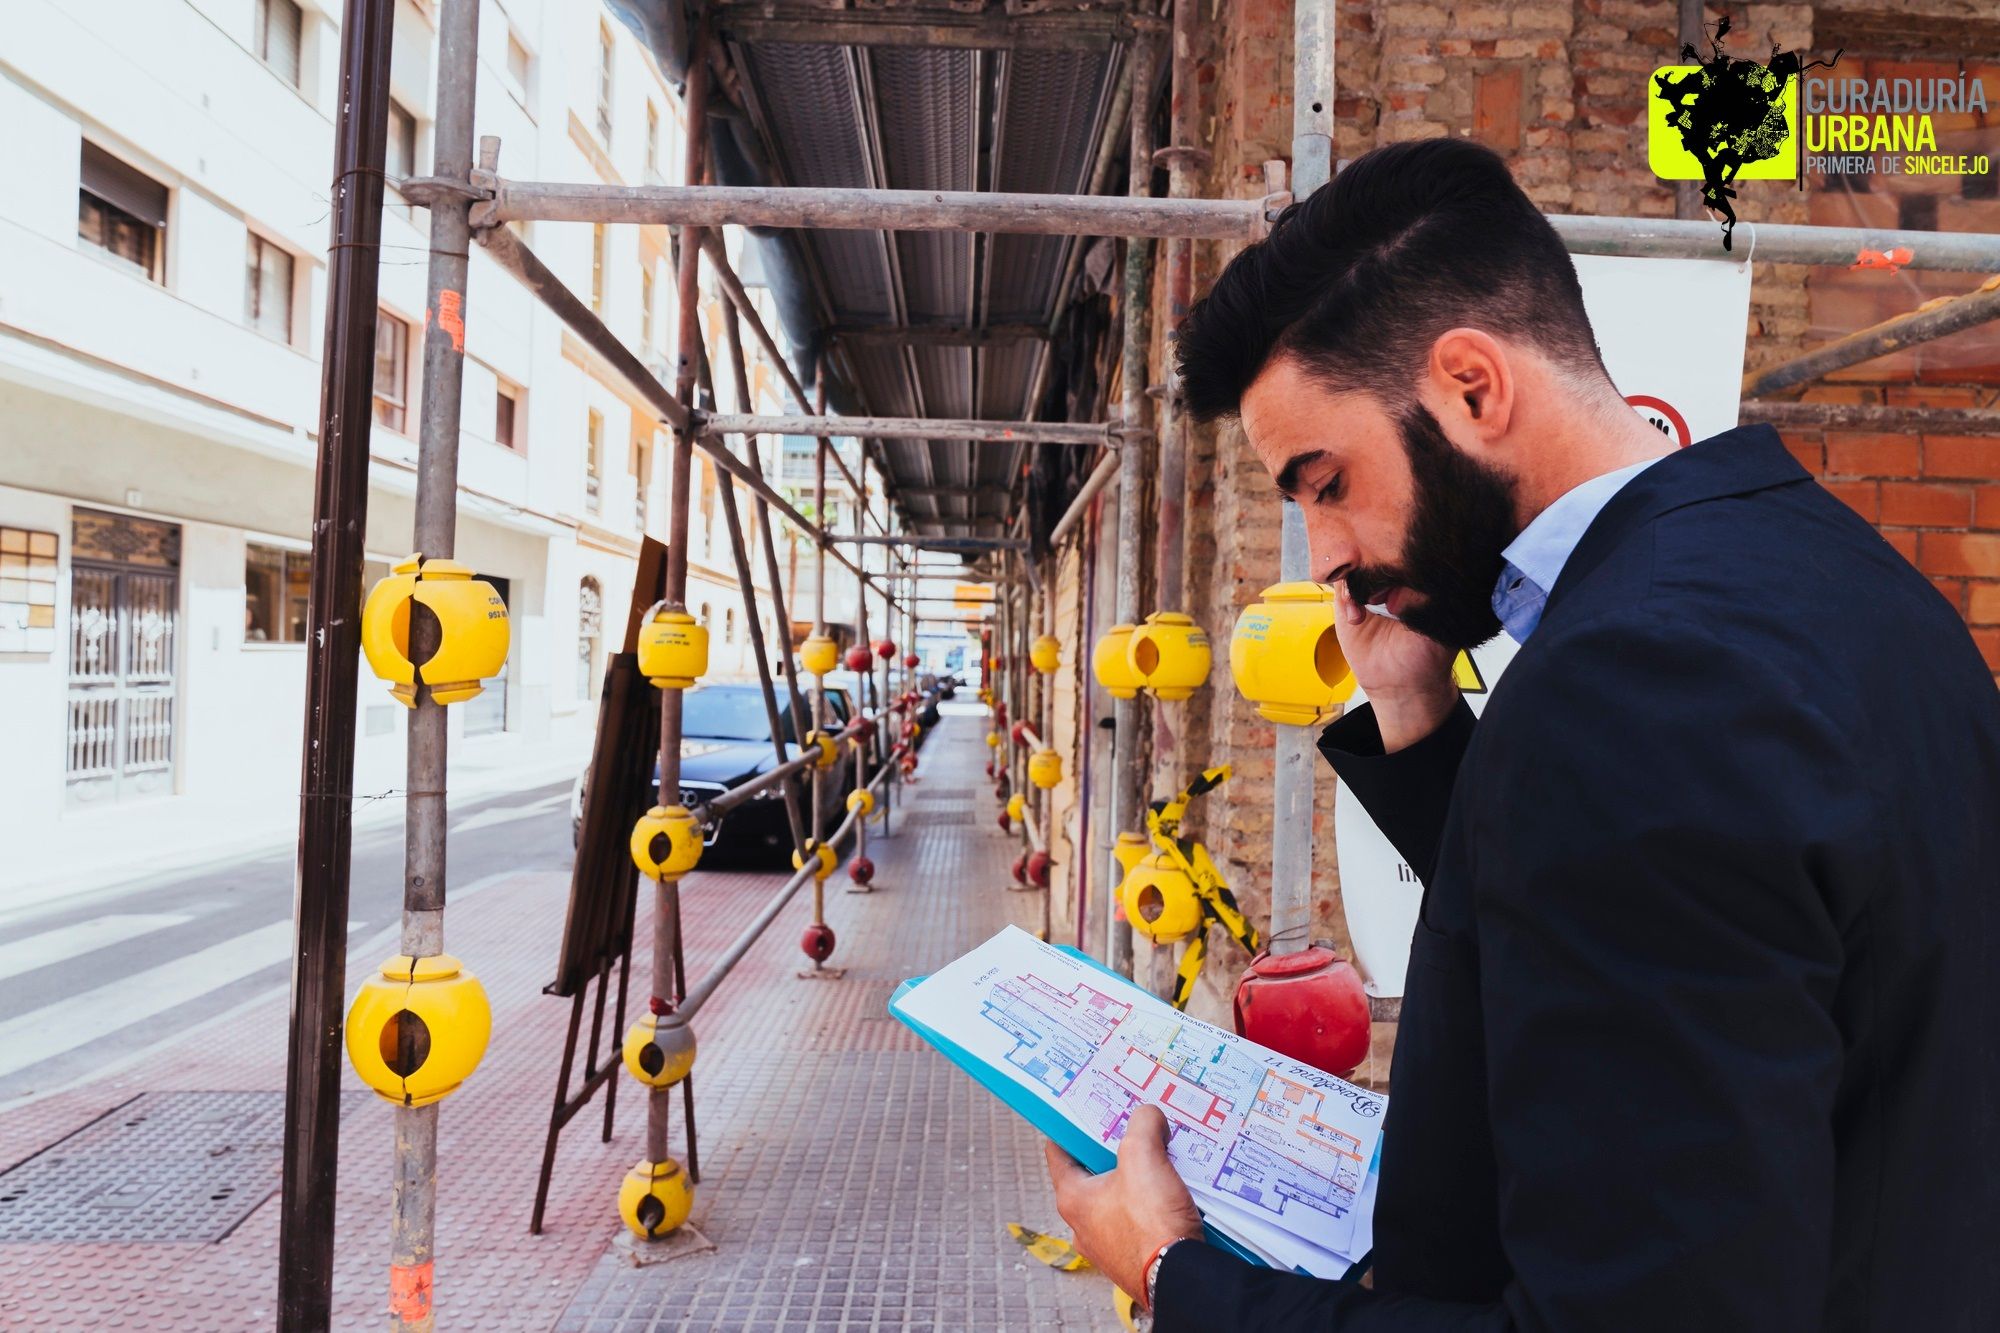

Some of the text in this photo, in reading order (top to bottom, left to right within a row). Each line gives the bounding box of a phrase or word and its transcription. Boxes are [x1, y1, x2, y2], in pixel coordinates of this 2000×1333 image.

[1173, 1011, 1240, 1044] Calle Saavedra
[1288, 1065, 1383, 1118] Barcelona
